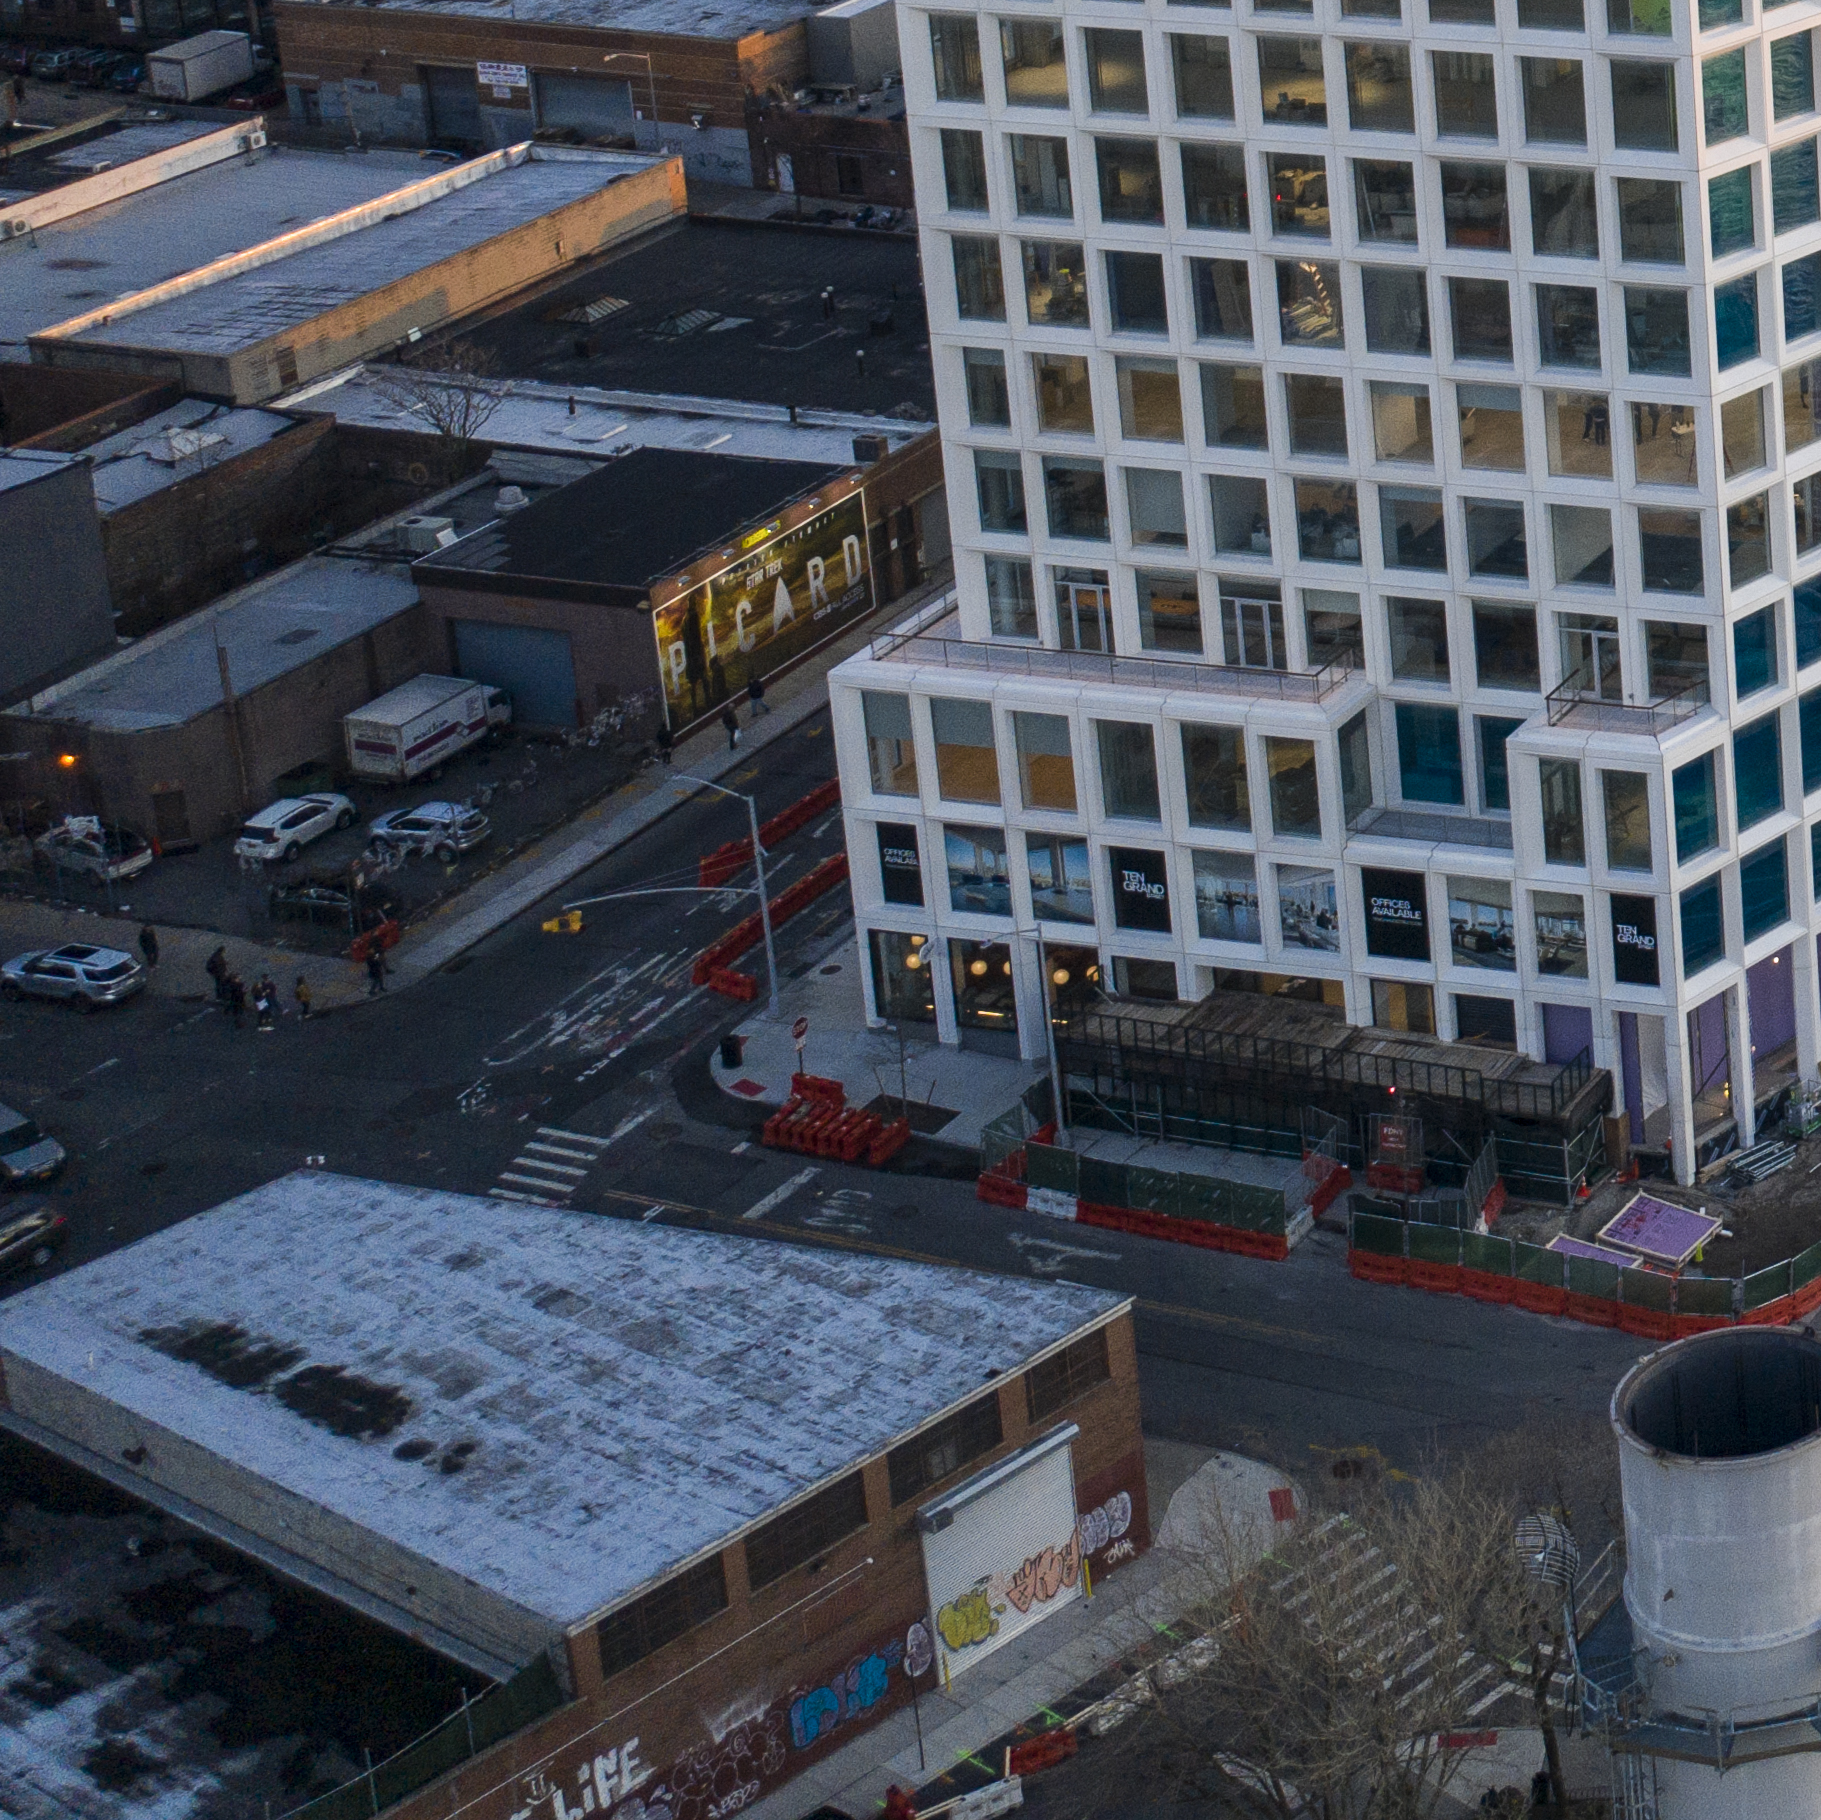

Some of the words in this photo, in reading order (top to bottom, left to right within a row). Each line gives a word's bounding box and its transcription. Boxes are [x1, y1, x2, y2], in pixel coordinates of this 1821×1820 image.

[766, 557, 783, 579] TREK
[1122, 870, 1145, 883] TEN
[1123, 880, 1165, 895] GRAND
[1371, 897, 1411, 910] OFFICES
[1371, 906, 1422, 920] AVAILABLE
[1616, 924, 1637, 935] TEN
[1617, 933, 1655, 946] GRAND
